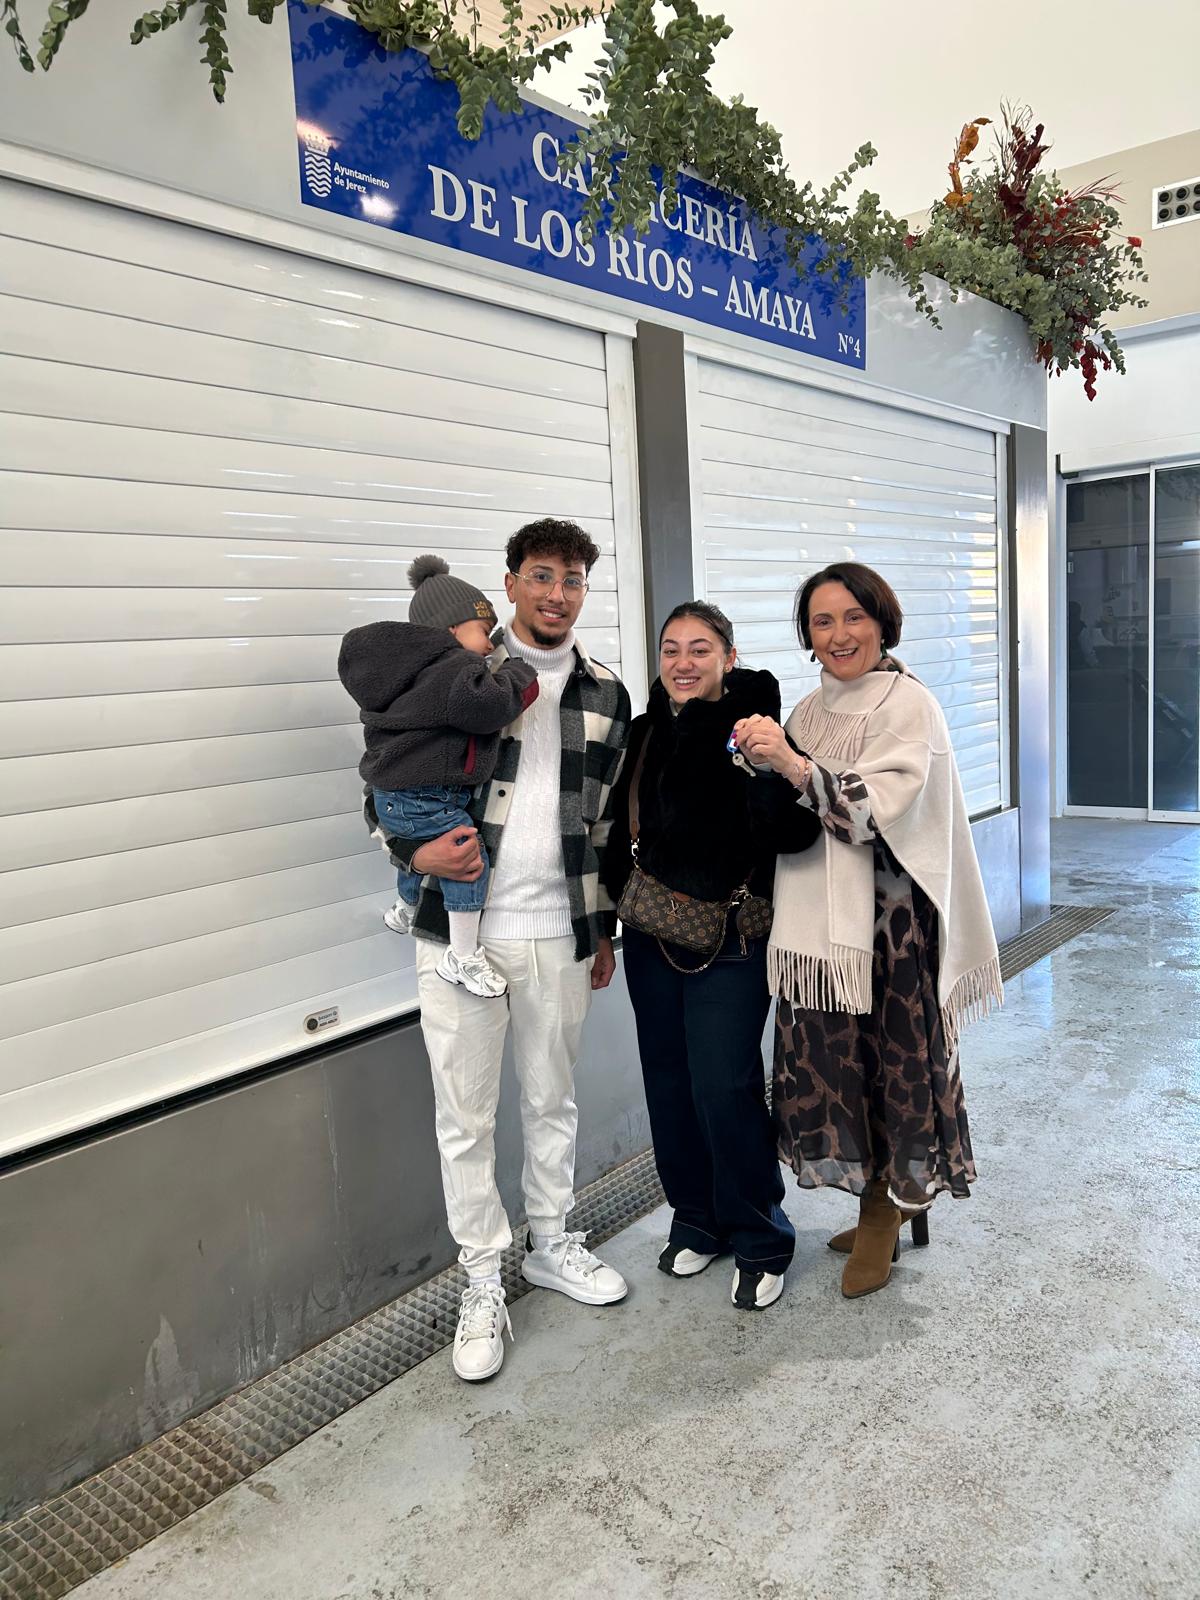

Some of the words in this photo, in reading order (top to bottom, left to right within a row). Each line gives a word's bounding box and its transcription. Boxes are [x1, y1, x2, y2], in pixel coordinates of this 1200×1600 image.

[334, 162, 390, 189] Ayuntamiento
[334, 175, 345, 186] de
[346, 178, 367, 194] Jerez
[533, 132, 757, 262] CACERÍA
[428, 164, 500, 237] DE
[512, 196, 596, 267] LOS
[606, 233, 694, 299] RIOS
[724, 275, 817, 341] AMAYA
